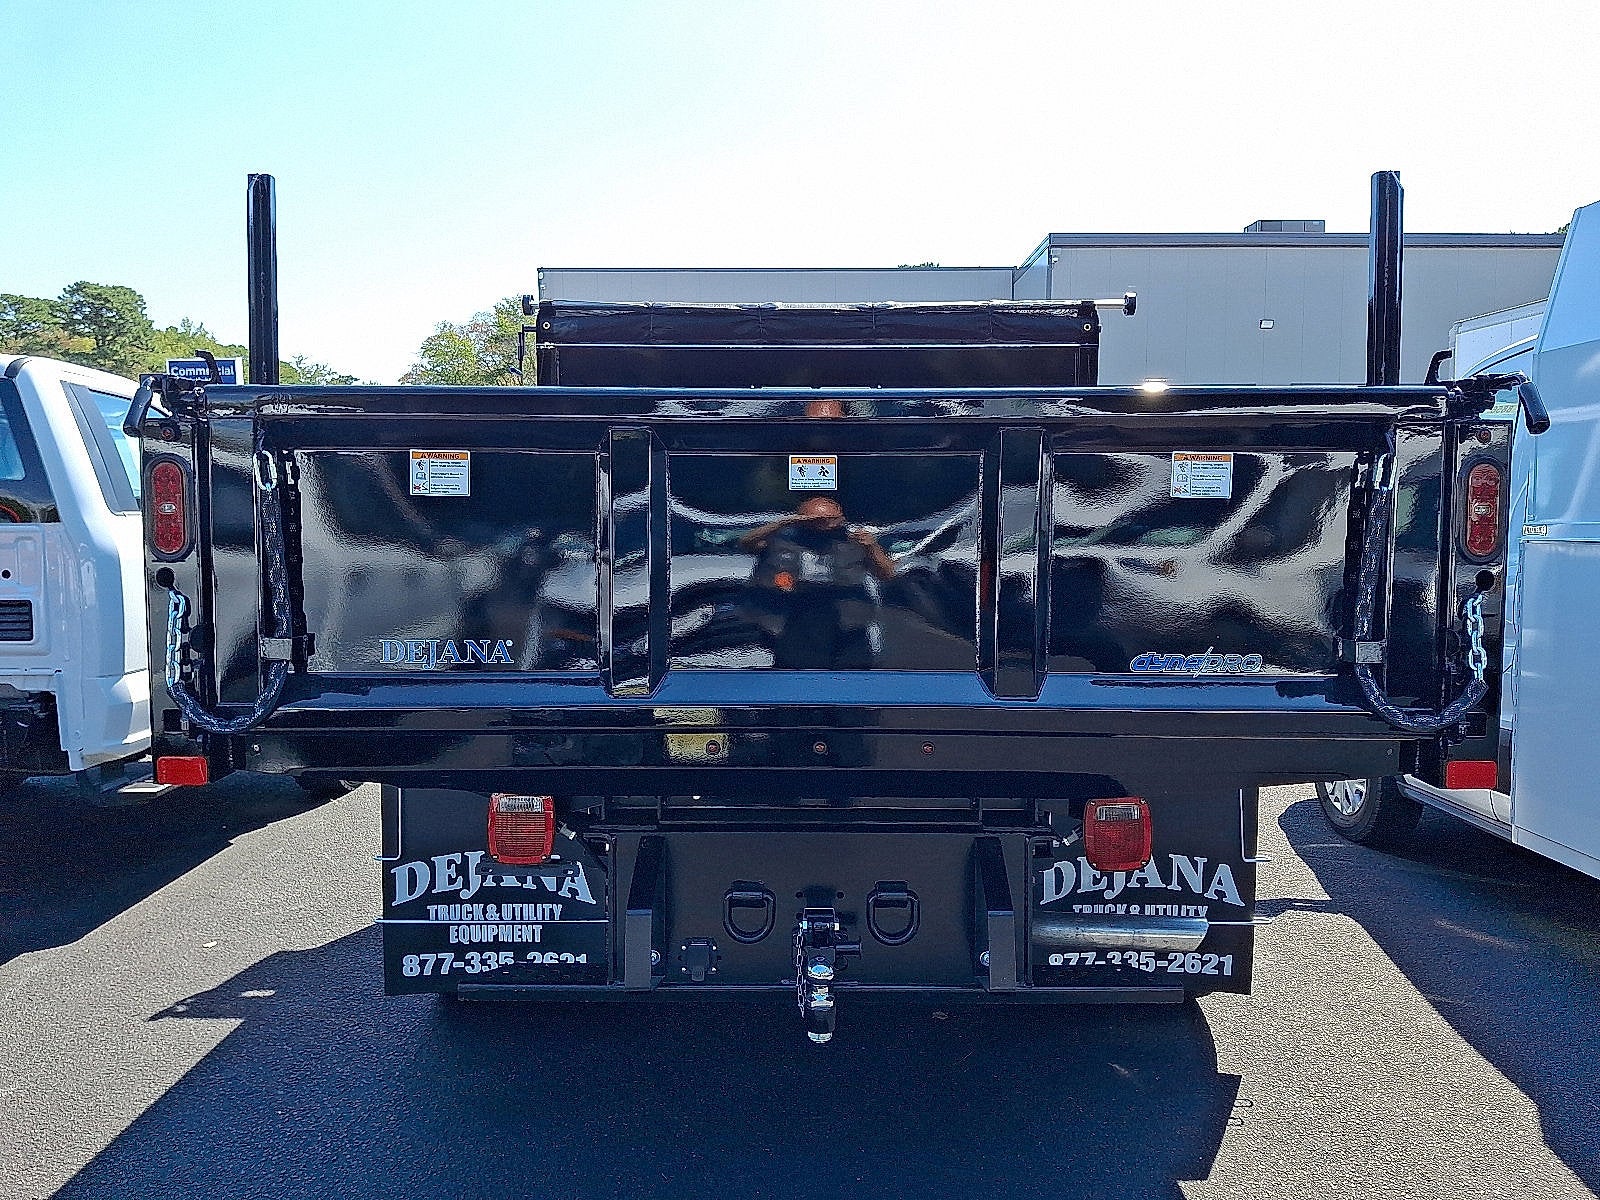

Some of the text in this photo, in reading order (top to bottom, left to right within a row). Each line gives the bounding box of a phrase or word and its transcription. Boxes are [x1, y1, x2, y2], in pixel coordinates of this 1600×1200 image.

[170, 365, 235, 376] Commial
[379, 639, 514, 670] DEJANA
[427, 903, 485, 921] TRUCK
[502, 903, 563, 921] UTILITY
[449, 924, 543, 945] EQUIPMENT
